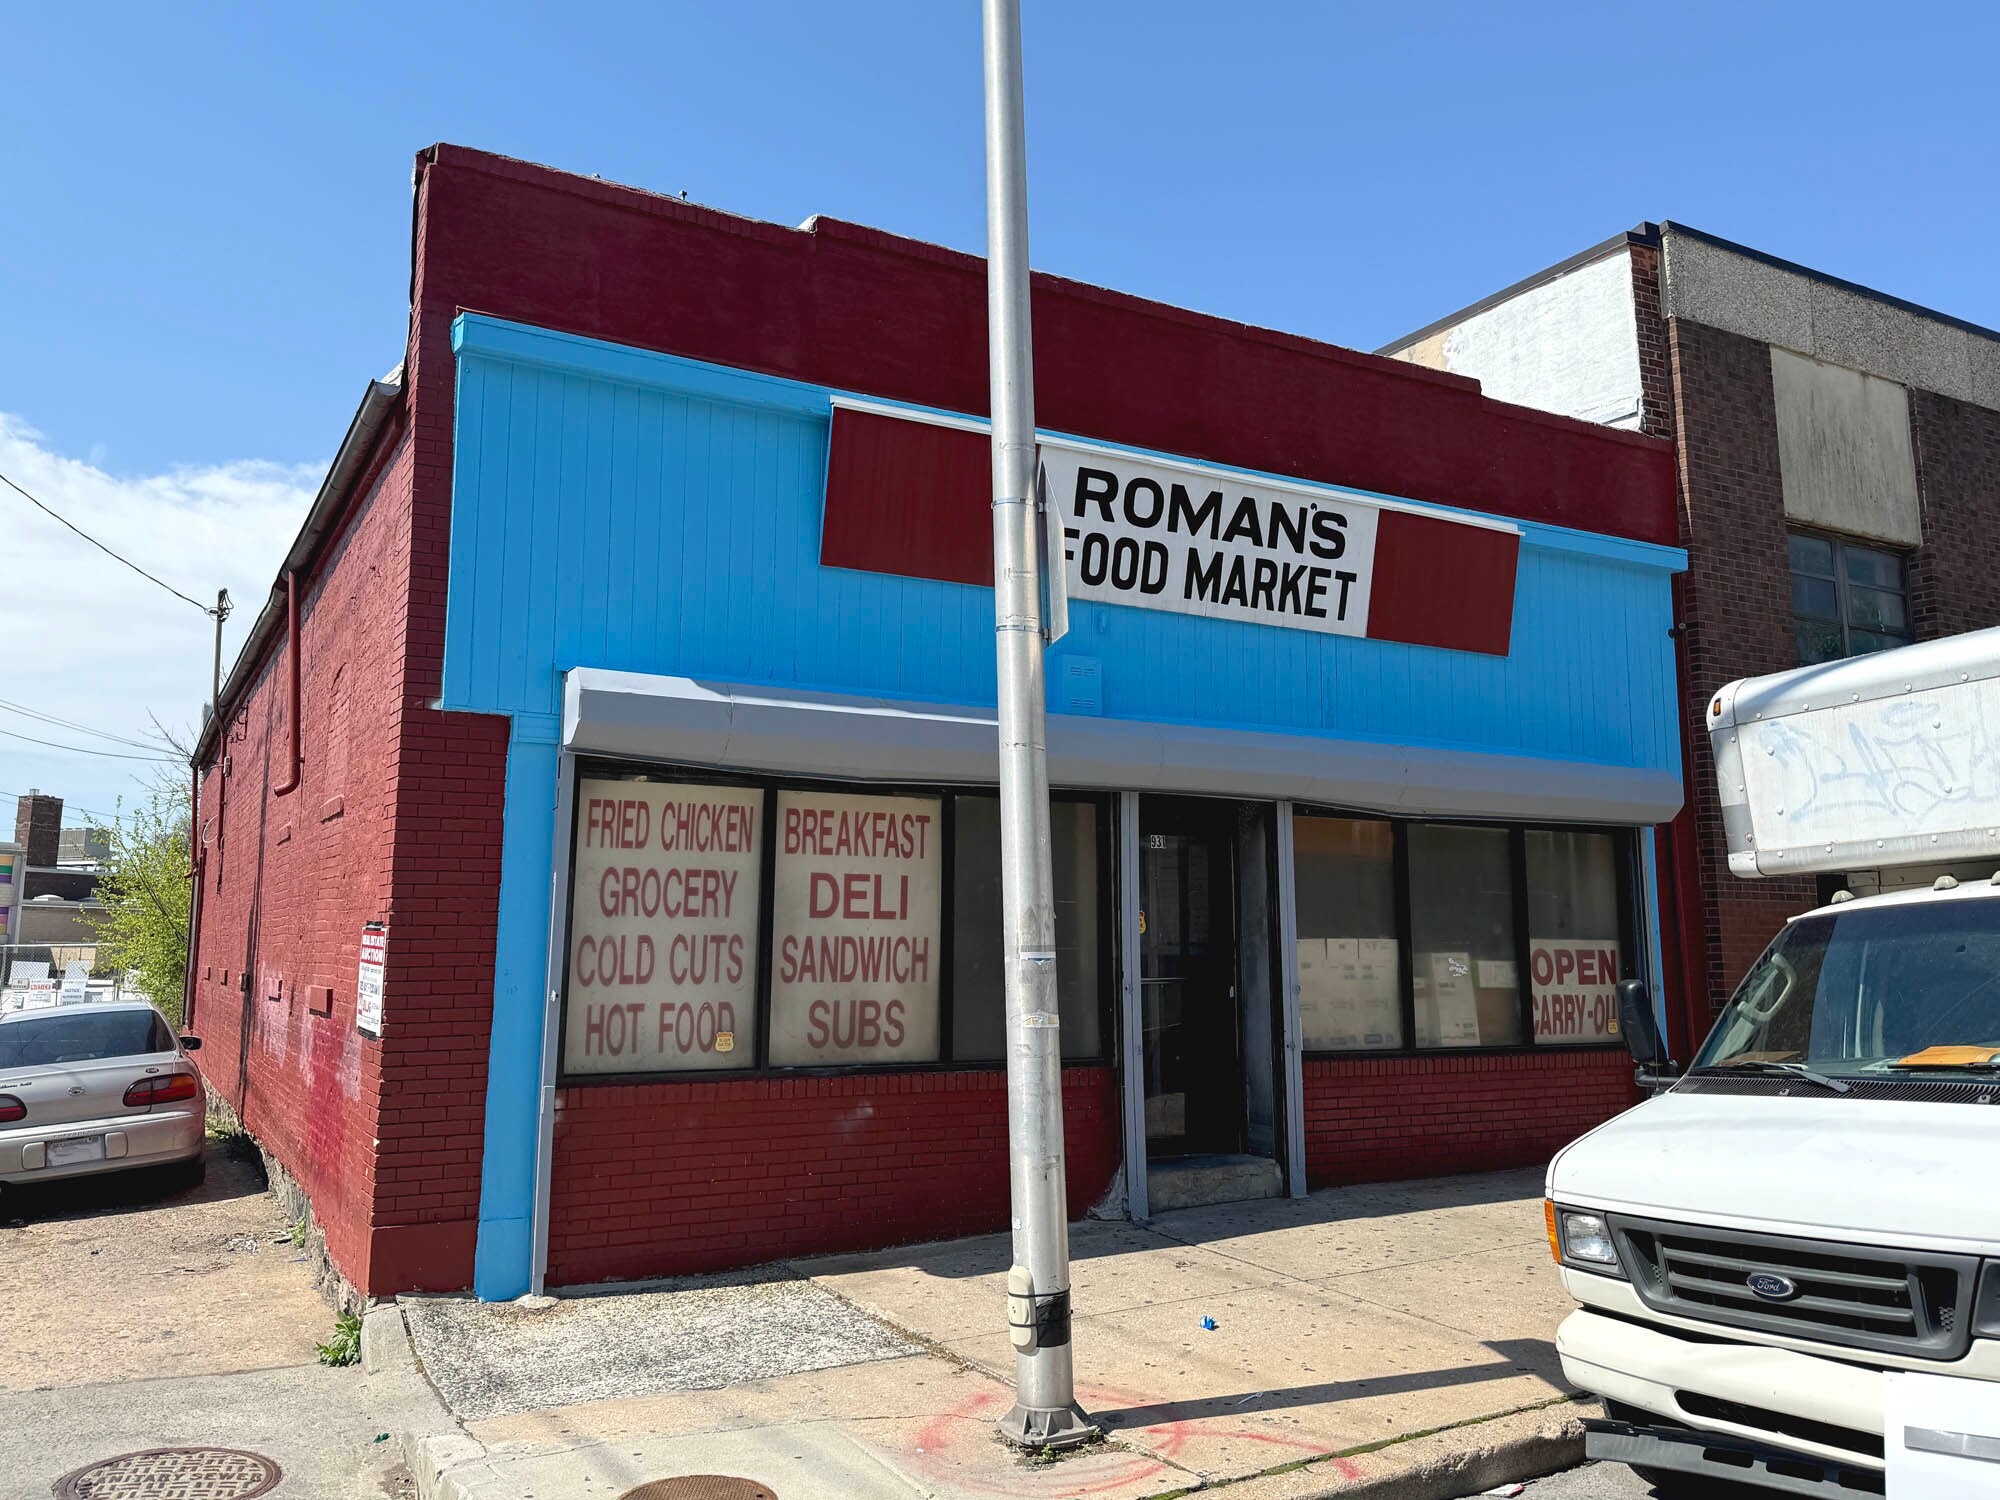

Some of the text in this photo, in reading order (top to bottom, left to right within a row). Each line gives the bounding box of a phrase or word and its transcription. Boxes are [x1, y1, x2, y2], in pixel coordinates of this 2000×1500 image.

[1073, 466, 1348, 560] ROMAN'S
[1184, 547, 1357, 621] MARKET
[586, 798, 754, 854] FRIED CHICKEN
[784, 807, 930, 860] BREAKFAST
[1151, 835, 1165, 848] 931
[600, 866, 738, 919] GROCERY
[809, 872, 909, 921] DELI
[577, 933, 744, 988] COLD CUTS
[780, 935, 929, 985] SANDWICH
[1532, 948, 1617, 986] OPEN
[585, 1001, 735, 1057] HOT FOOD
[807, 999, 905, 1049] SUBS
[1757, 1277, 1780, 1292] Ford
[189, 1472, 262, 1483] SEWER
